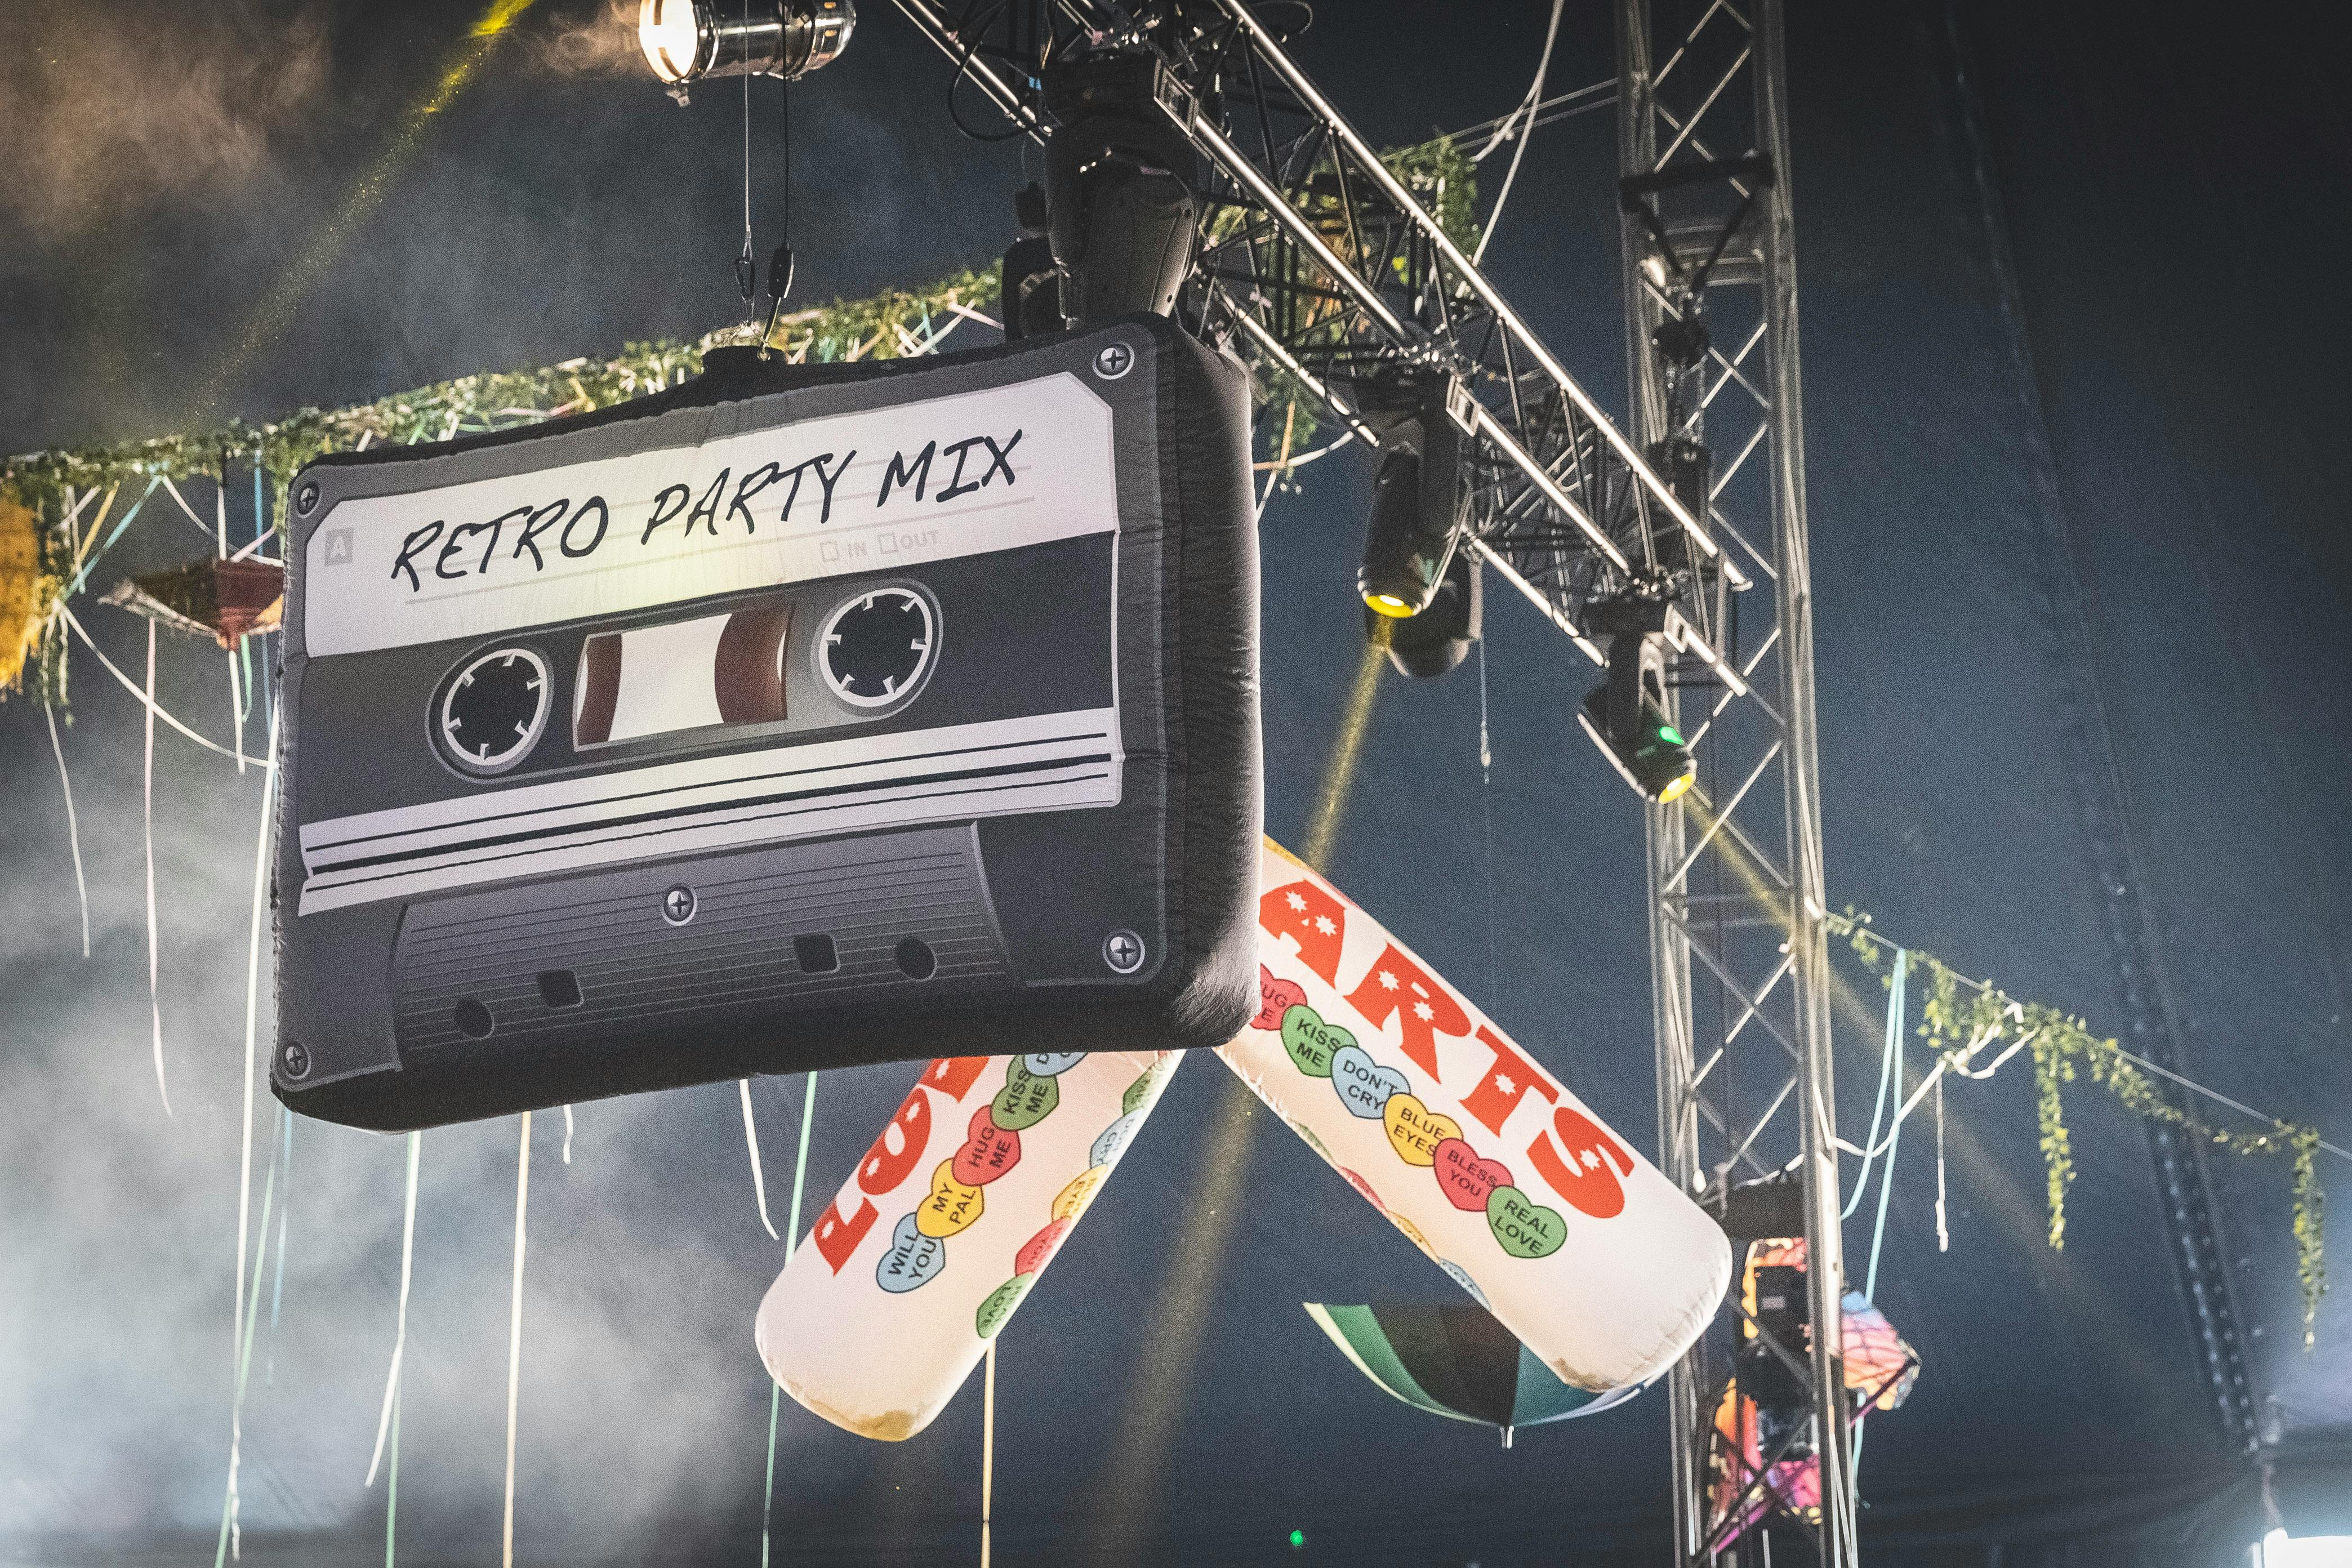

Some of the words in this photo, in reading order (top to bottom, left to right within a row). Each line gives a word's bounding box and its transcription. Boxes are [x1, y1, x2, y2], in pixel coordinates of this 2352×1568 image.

[391, 496, 609, 593] RETRO
[641, 449, 857, 545] PARTY
[877, 429, 1022, 507] MIX
[330, 533, 347, 559] A
[846, 541, 868, 558] IN
[899, 529, 939, 550] OUT
[1259, 878, 1635, 1219] ARTS
[1296, 1018, 1341, 1052] KISS
[1296, 1043, 1325, 1068] ME
[1004, 1069, 1032, 1114] KISS
[1343, 1059, 1398, 1097] DON'T
[1025, 1083, 1049, 1114] ME
[1348, 1084, 1384, 1111] CRY
[1393, 1124, 1436, 1156] EYES
[1400, 1107, 1445, 1141] BLUE
[968, 1126, 995, 1168] HUG
[989, 1139, 1012, 1169] ME
[1447, 1149, 1497, 1188] BLESS
[1450, 1170, 1482, 1197] YOU
[932, 1182, 953, 1213] MY
[949, 1190, 977, 1224] PAL
[1495, 1216, 1543, 1255] LOVE
[1504, 1199, 1550, 1239] REAL
[888, 1232, 919, 1275] WILL
[908, 1239, 937, 1279] YOU
